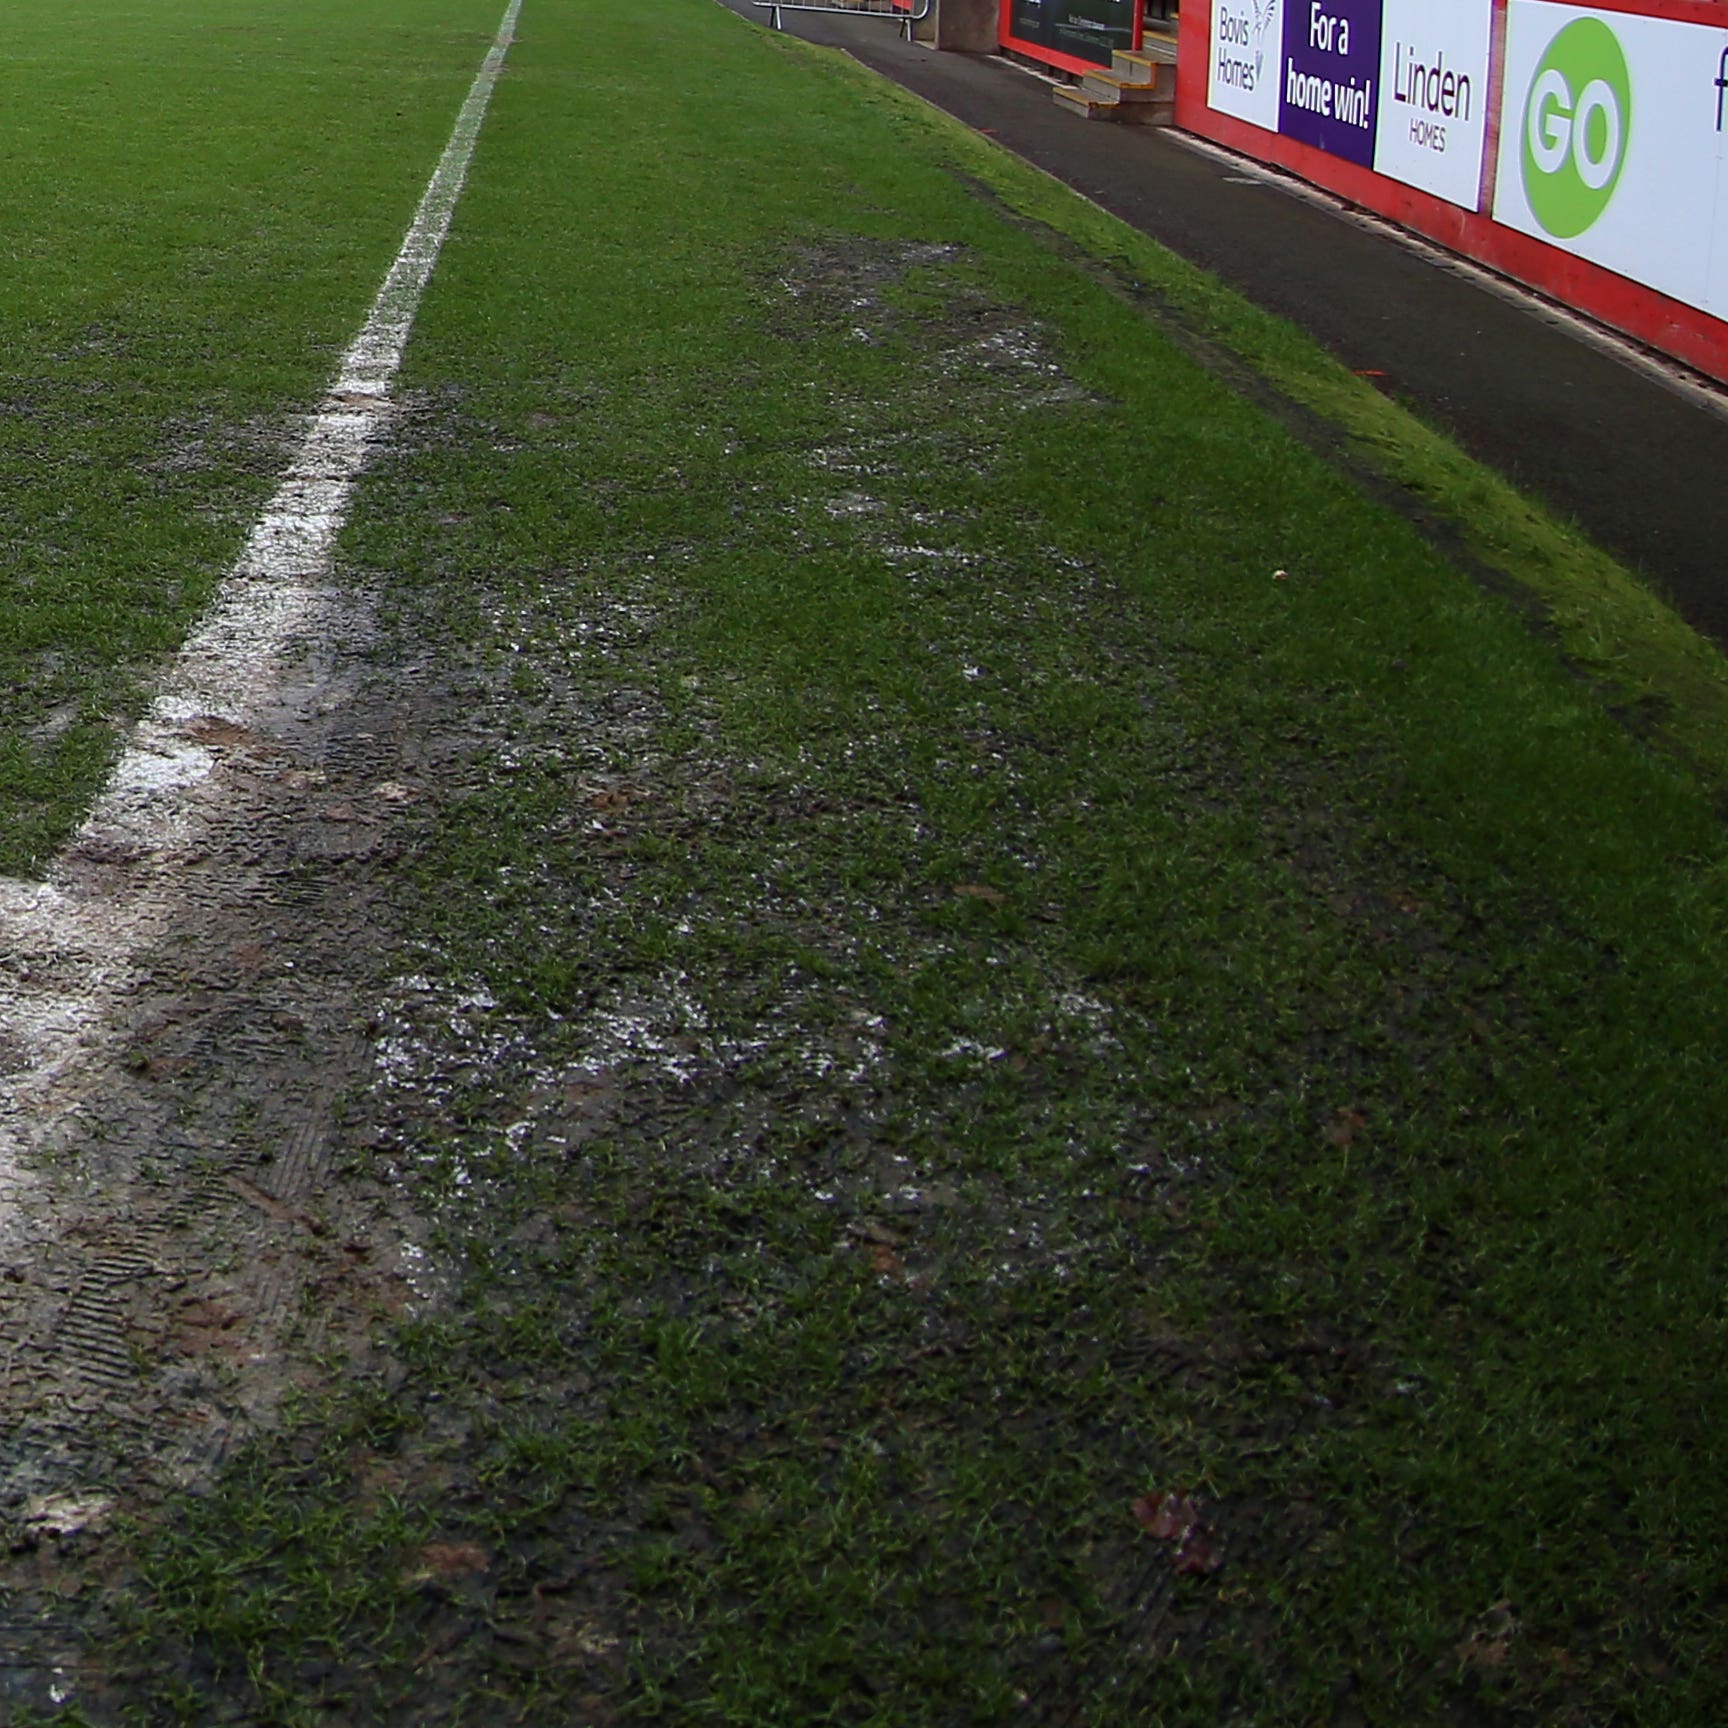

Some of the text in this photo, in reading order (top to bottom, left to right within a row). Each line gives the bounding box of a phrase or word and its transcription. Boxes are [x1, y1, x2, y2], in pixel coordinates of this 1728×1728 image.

[1219, 6, 1249, 46] Bovis
[1309, 1, 1350, 56] For a
[1217, 47, 1255, 91] Homes
[1286, 57, 1371, 130] home win!
[1393, 41, 1470, 121] Linden
[1409, 118, 1446, 153] HOMES
[1527, 68, 1620, 190] GO
